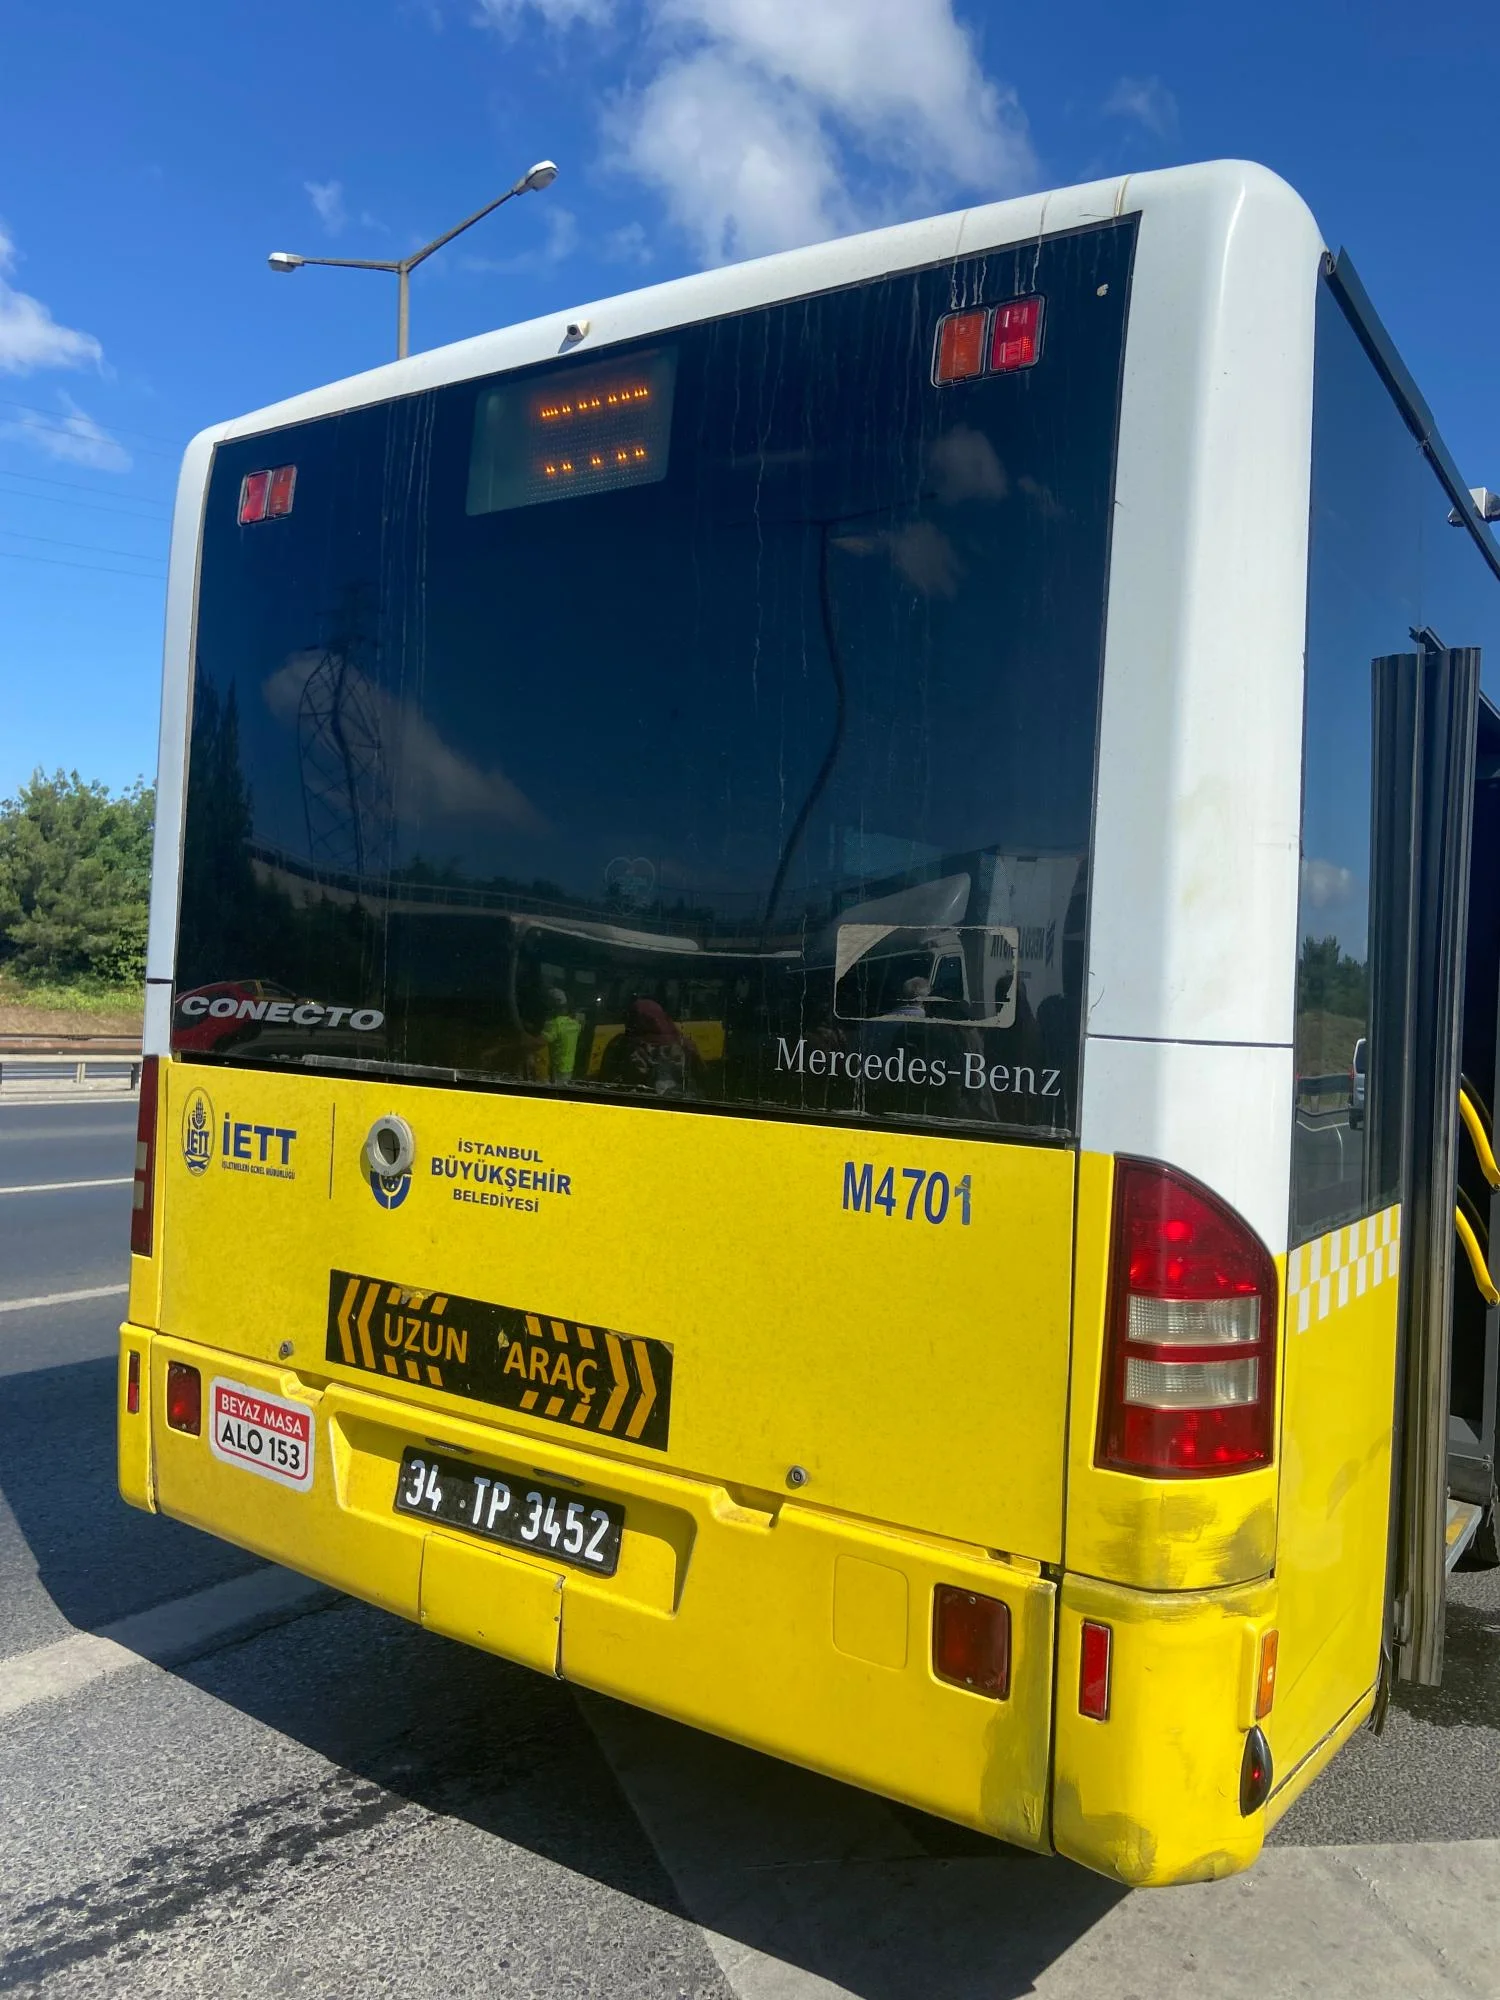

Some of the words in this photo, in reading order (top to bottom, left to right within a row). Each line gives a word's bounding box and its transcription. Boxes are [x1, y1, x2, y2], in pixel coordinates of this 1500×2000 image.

[181, 996, 385, 1031] CONECTO
[774, 1037, 1061, 1097] Mercedes-Benz
[222, 1112, 297, 1165] İETT
[458, 1137, 543, 1163] İSTANBUL
[431, 1155, 572, 1195] BÜYÜKŞEHİR
[842, 1161, 972, 1225] M4701
[453, 1188, 539, 1213] BELEDİYESİ
[384, 1313, 468, 1364] UZUN
[503, 1341, 598, 1404] ARAÇ
[221, 1393, 261, 1422] BEYAZ
[263, 1408, 303, 1437] MASA
[221, 1420, 263, 1455] ALO
[268, 1437, 300, 1470] 153
[405, 1459, 442, 1512] 34
[472, 1477, 511, 1529] TP
[520, 1491, 610, 1562] 3452
